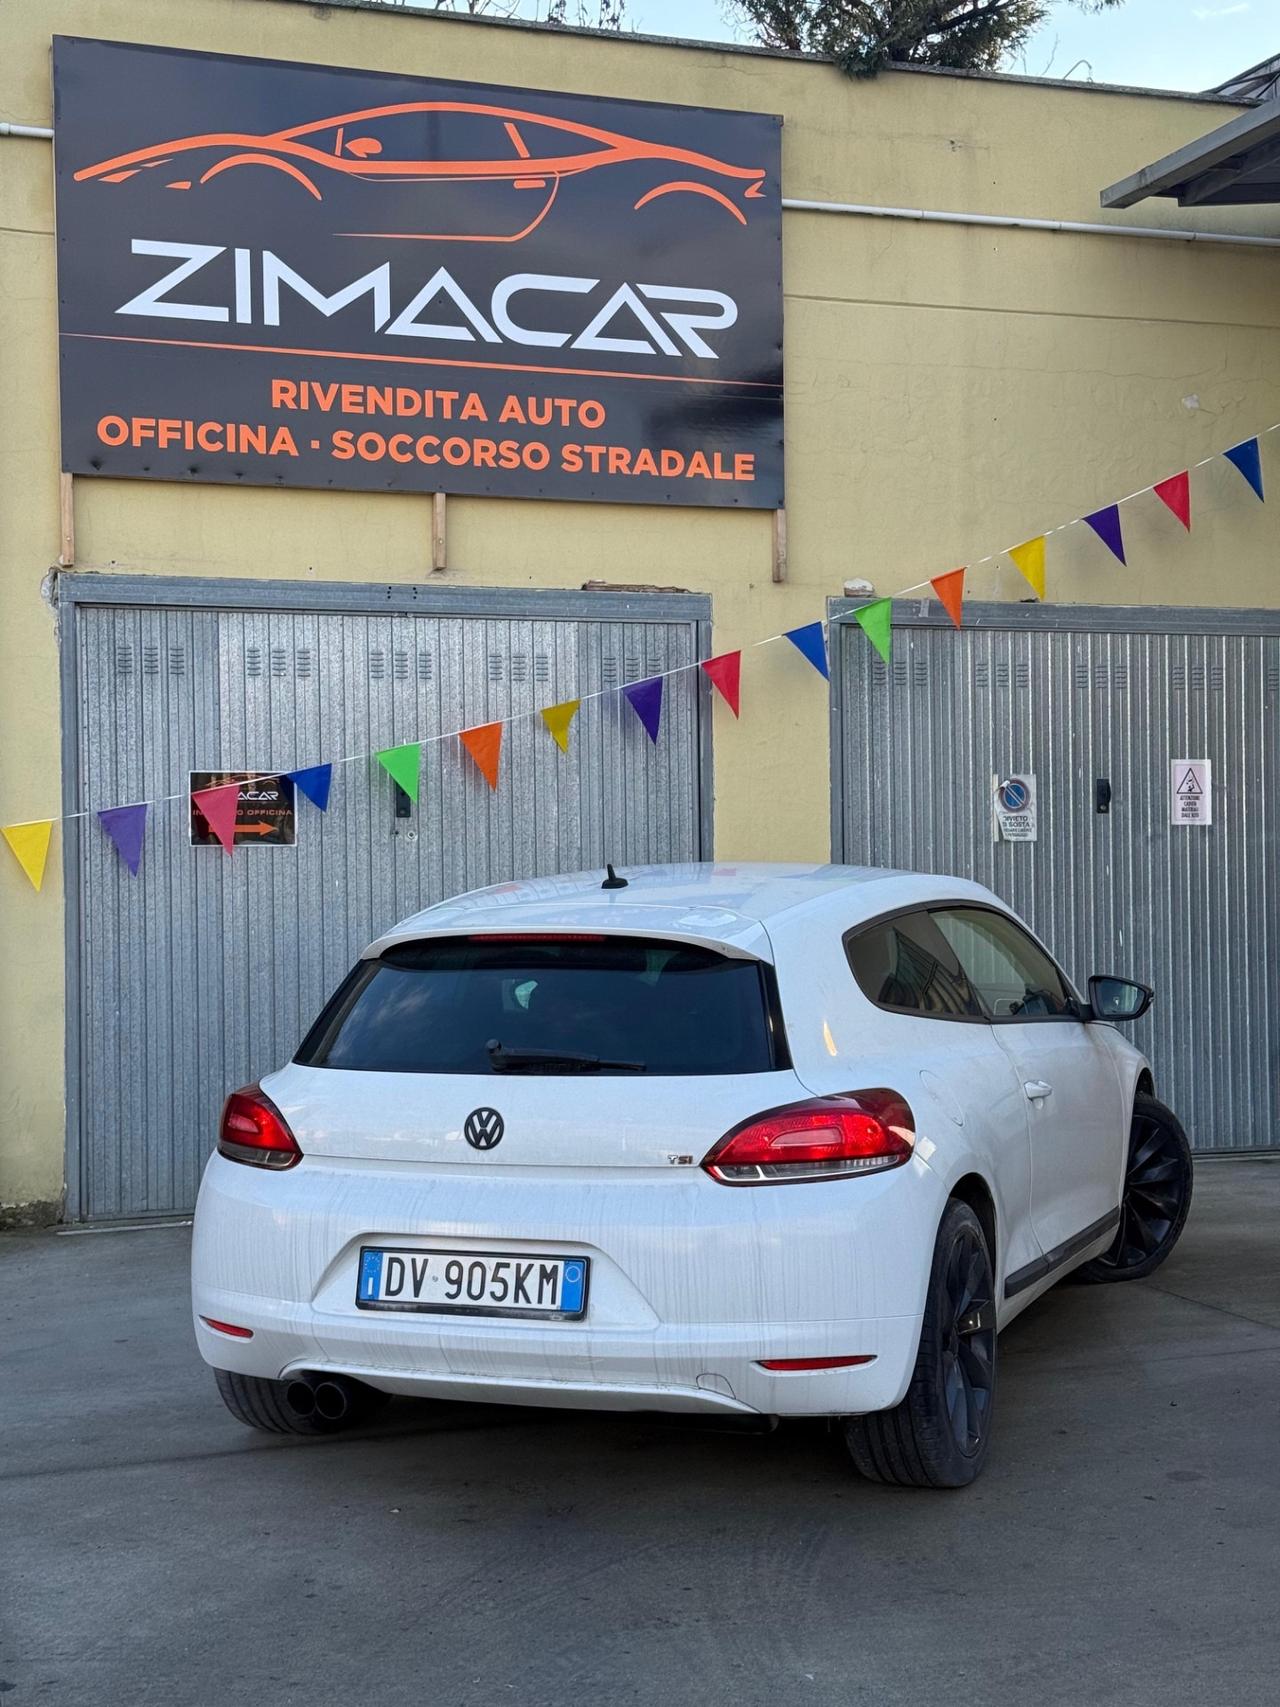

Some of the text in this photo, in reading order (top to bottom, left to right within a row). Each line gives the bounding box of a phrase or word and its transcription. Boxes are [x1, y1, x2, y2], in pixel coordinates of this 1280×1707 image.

[115, 238, 739, 360] ZIMACAR
[271, 379, 606, 429] RIVENDITA AUTO
[97, 415, 755, 481] OFFICINA SOCCORSO STRADALE
[237, 791, 279, 800] ACAR
[667, 1155, 693, 1164] TSI
[384, 1256, 429, 1298] DV
[444, 1259, 559, 1305] 905KM
